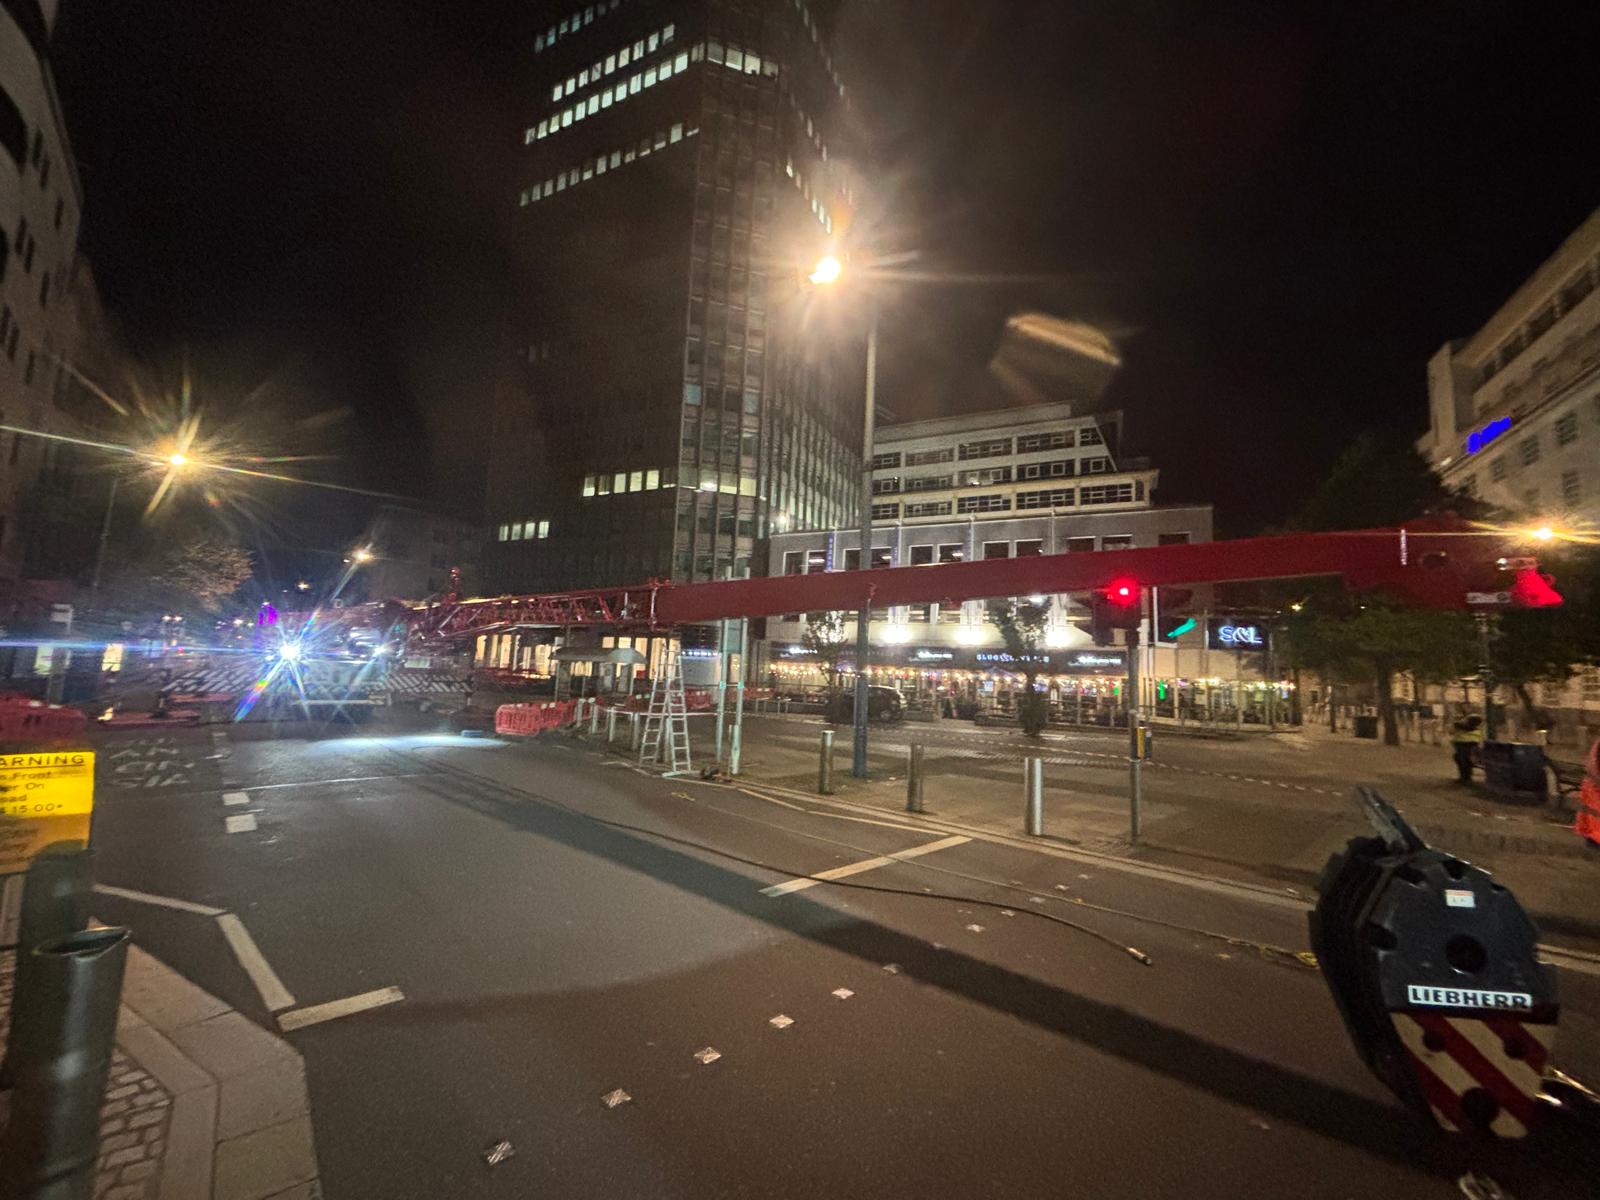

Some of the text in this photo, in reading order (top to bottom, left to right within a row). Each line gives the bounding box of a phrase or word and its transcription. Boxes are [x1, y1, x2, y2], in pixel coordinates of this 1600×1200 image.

[1218, 625, 1263, 644] S&L
[0, 755, 85, 767] ARNING
[1412, 988, 1529, 1008] LIEBHERR
